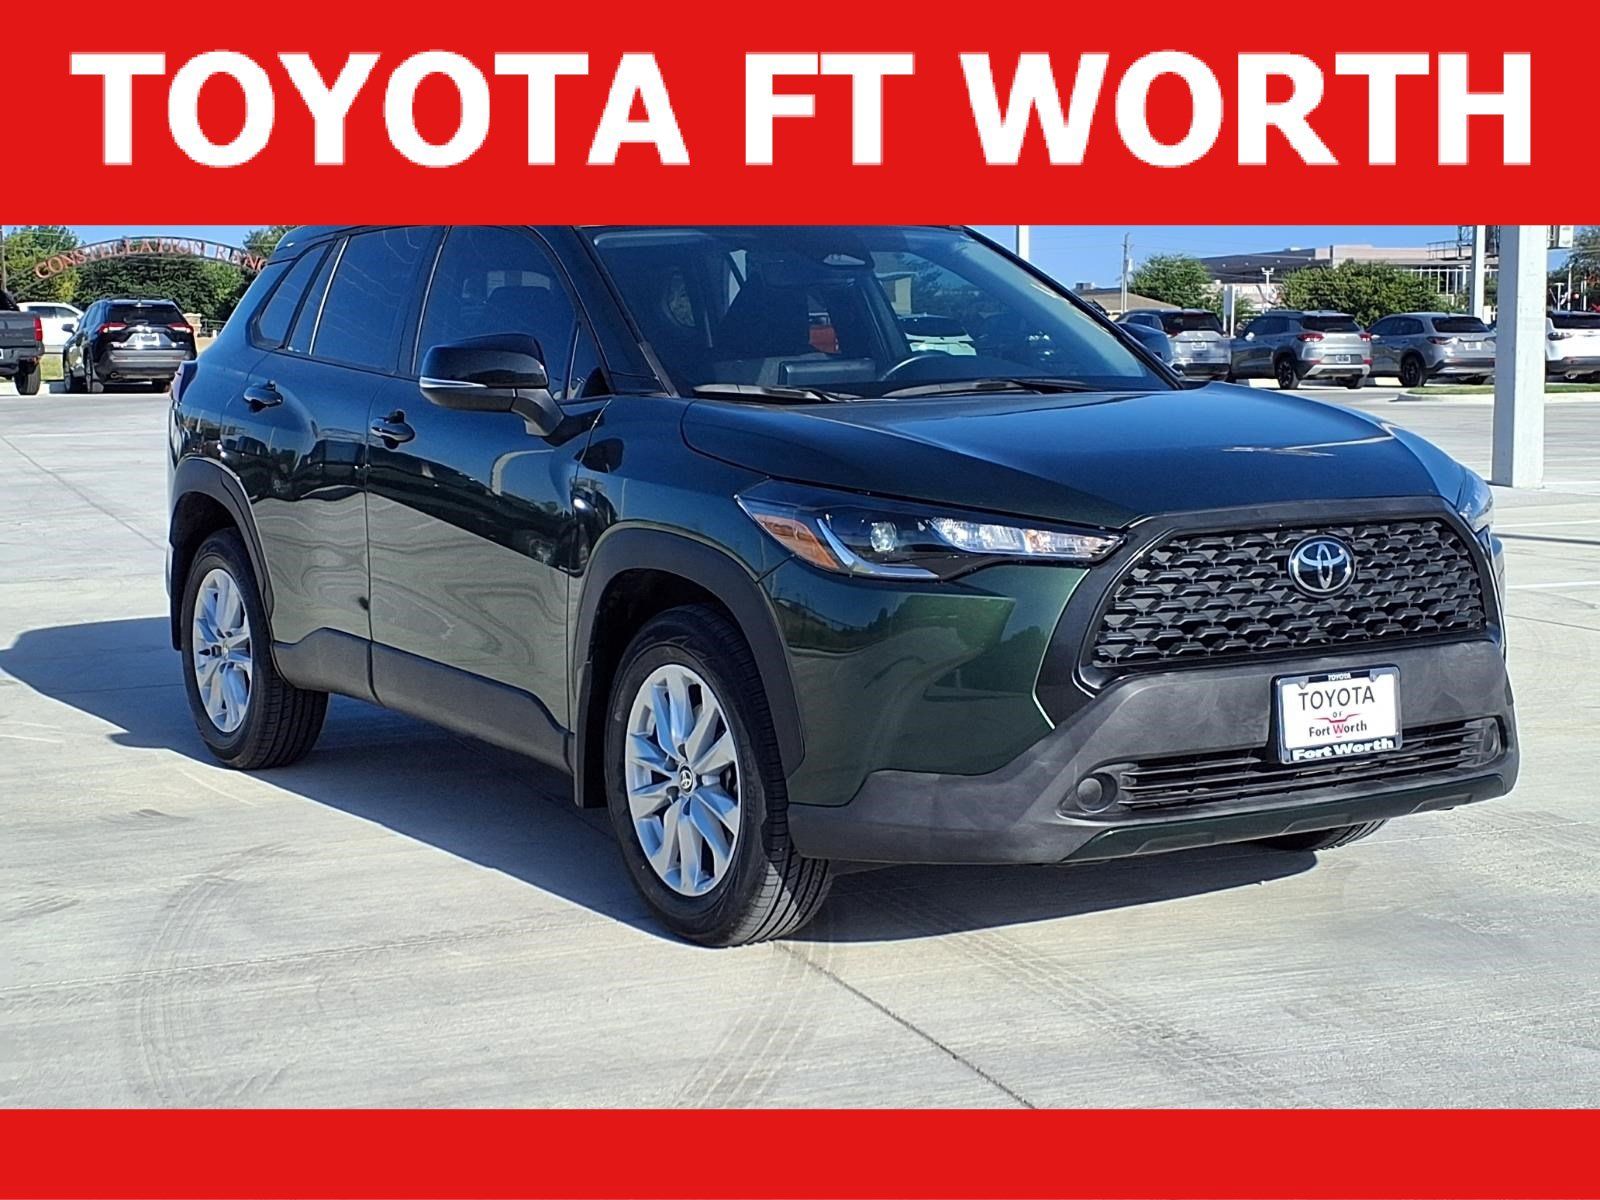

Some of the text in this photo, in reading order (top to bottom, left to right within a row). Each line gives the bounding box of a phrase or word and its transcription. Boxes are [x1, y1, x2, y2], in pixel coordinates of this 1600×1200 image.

[1328, 672, 1352, 681] TOYOTA
[1298, 685, 1375, 711] TOYOTA
[1309, 720, 1367, 738] Fort Worth
[1292, 738, 1394, 761] Fort Worth
